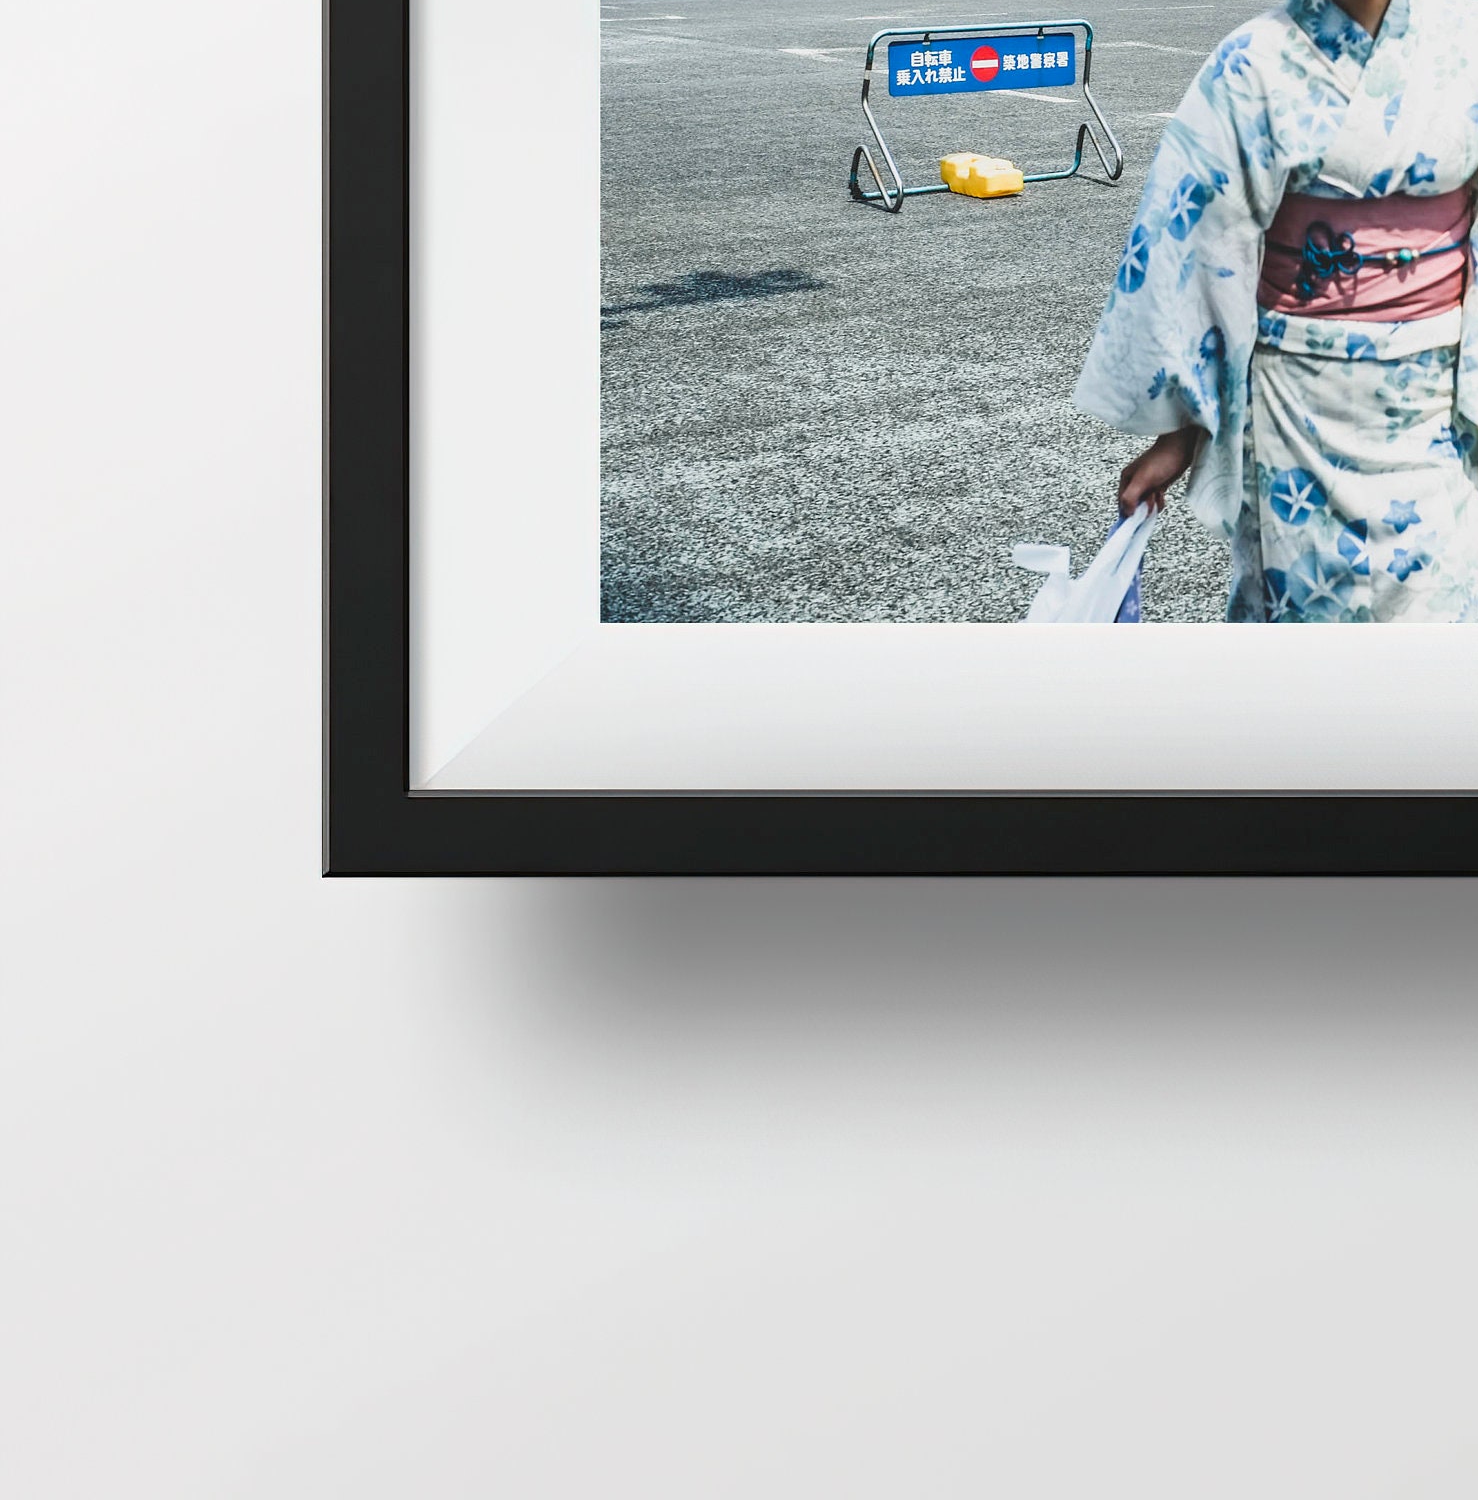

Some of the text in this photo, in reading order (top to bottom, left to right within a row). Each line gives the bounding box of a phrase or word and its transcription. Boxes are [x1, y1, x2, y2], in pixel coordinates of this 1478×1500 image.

[910, 50, 952, 67] 自転車
[1003, 52, 1068, 71] 築地警察署
[896, 67, 966, 85] 乗入れ禁止
